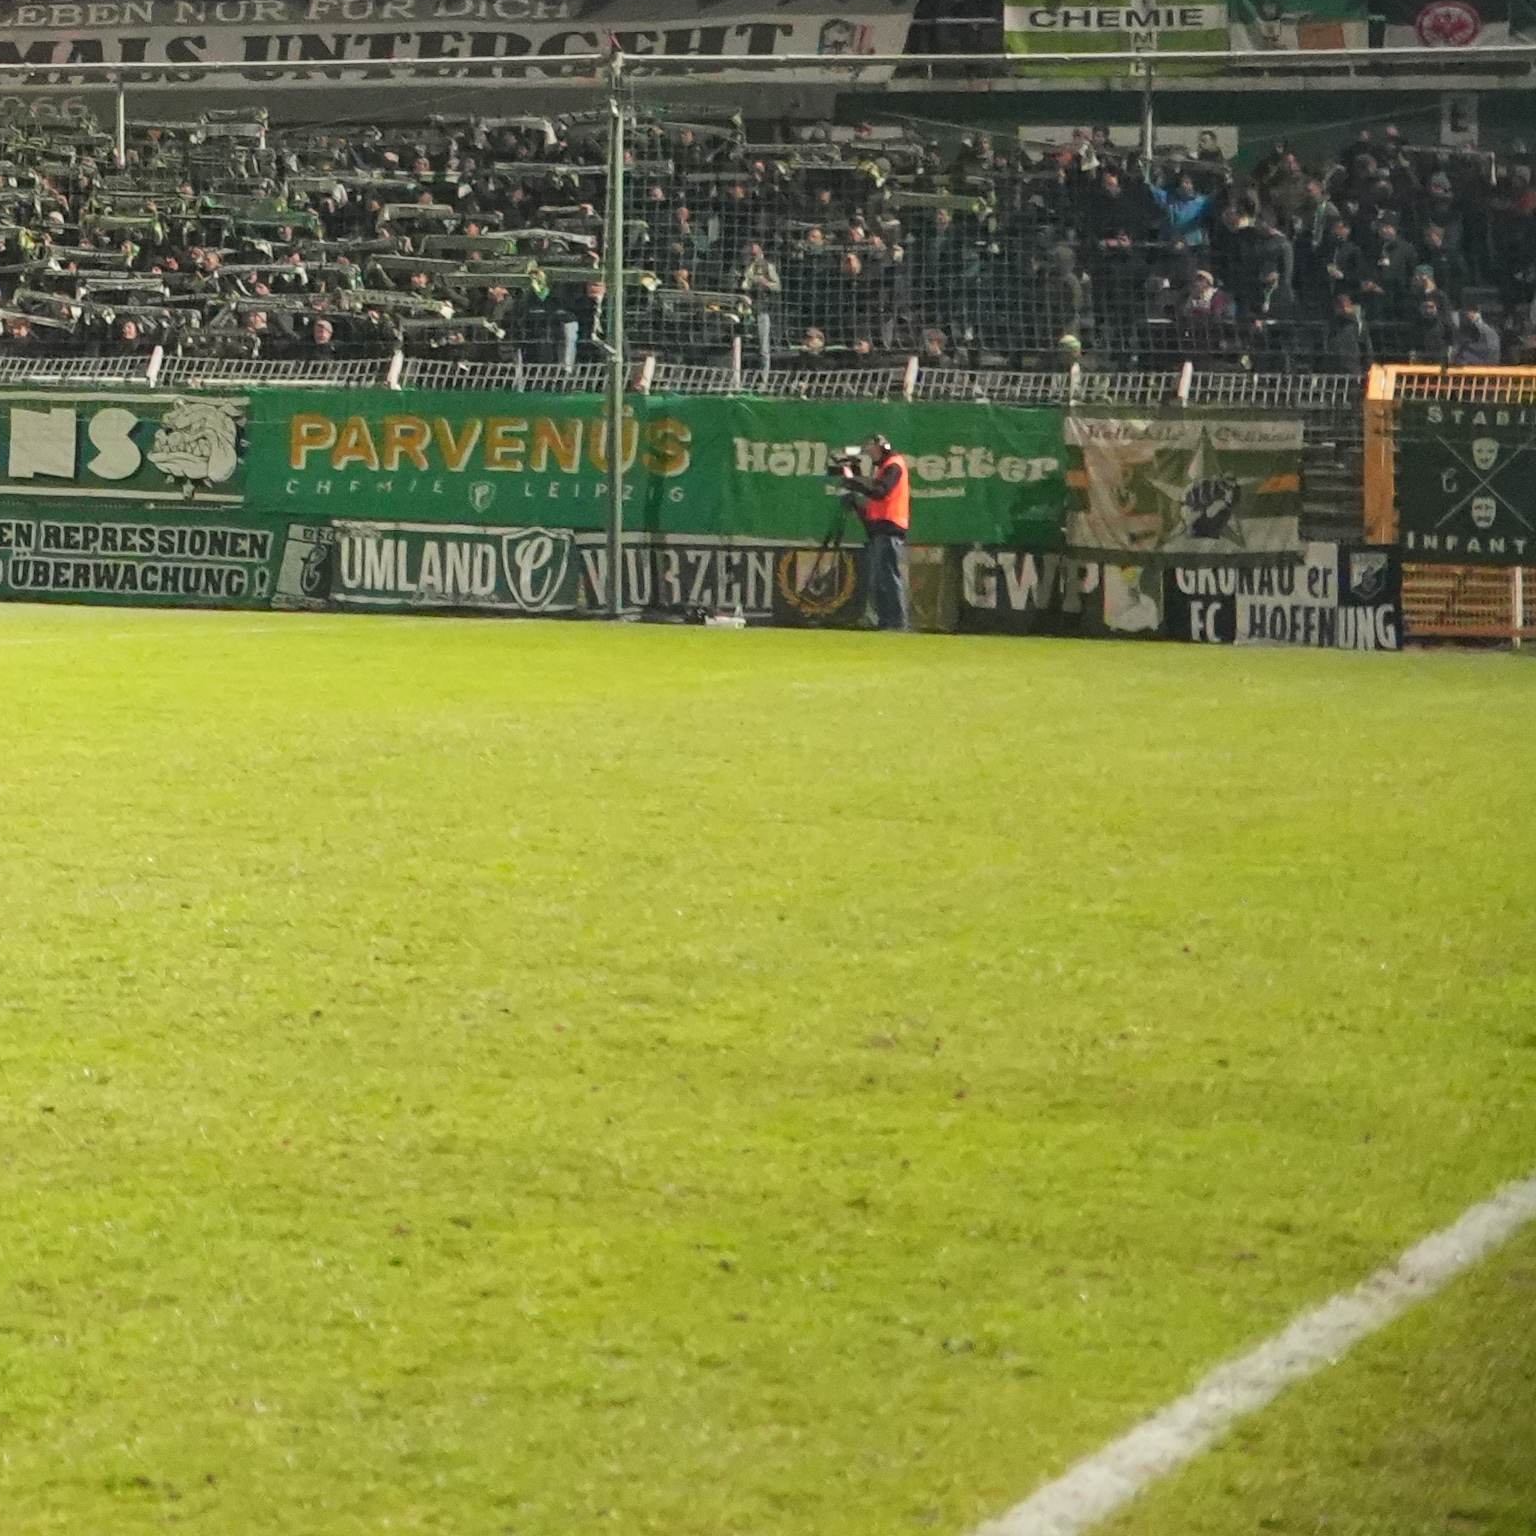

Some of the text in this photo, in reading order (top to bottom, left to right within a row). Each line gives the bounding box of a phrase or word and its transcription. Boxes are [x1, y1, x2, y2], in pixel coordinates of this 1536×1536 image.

[1028, 7, 1205, 28] CHEMIE
[240, 22, 795, 81] UNTERGEHT
[288, 403, 692, 478] PARVENÜS
[1427, 405, 1536, 426] STABI
[285, 479, 685, 503] CHEMIE LEIPZIG
[40, 520, 274, 563] REPRESSIONEN
[338, 535, 497, 596] UMLAND
[8, 547, 250, 598] ÜBERWACHUNG
[1190, 601, 1397, 651] FC HOFFNUNG
